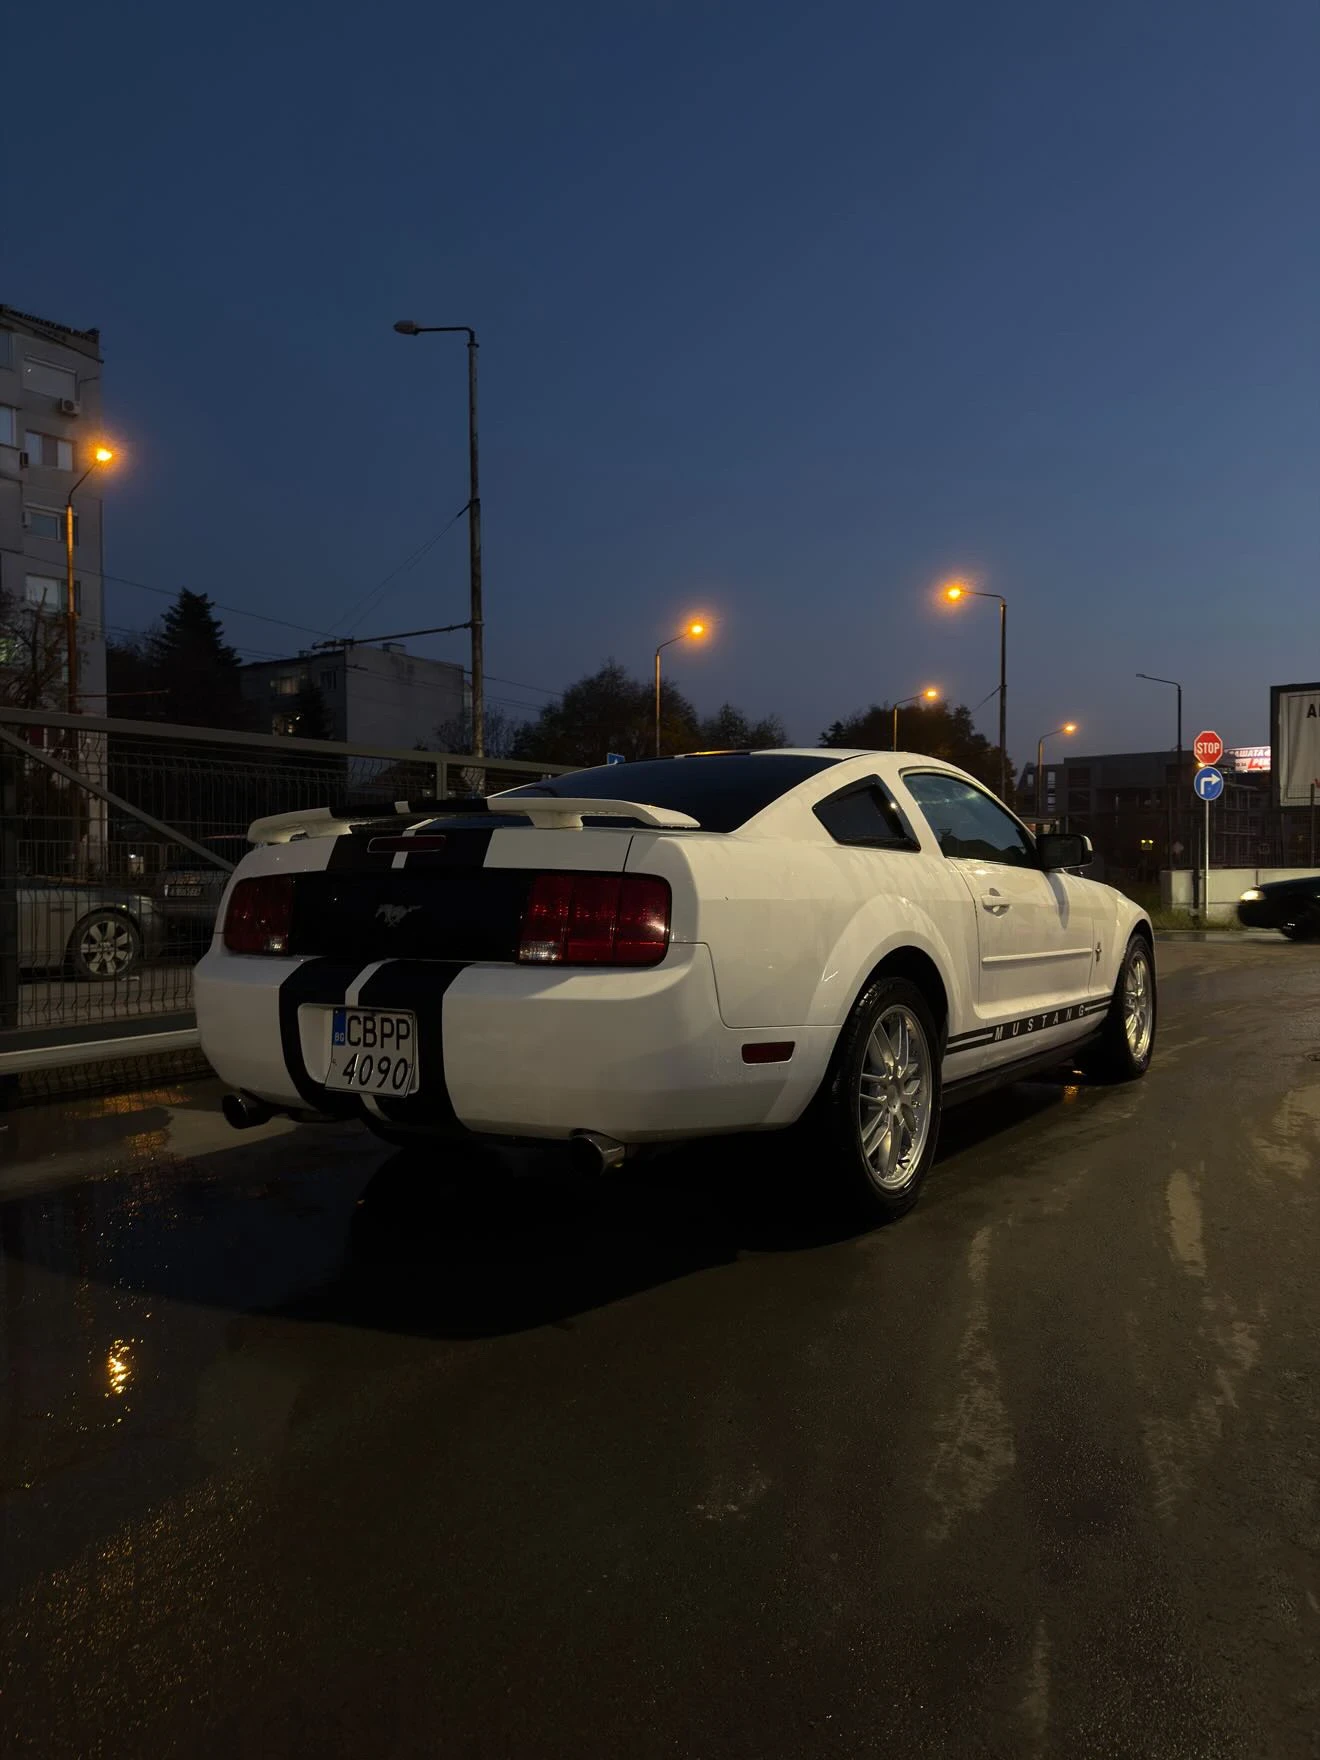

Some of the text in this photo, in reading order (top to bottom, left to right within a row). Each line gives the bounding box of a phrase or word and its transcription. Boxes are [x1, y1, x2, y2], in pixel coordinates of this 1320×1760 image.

[1197, 742, 1220, 754] STOP
[347, 1015, 410, 1050] CBPP
[996, 1005, 1085, 1040] MUSTANG
[343, 1053, 408, 1090] 4090
